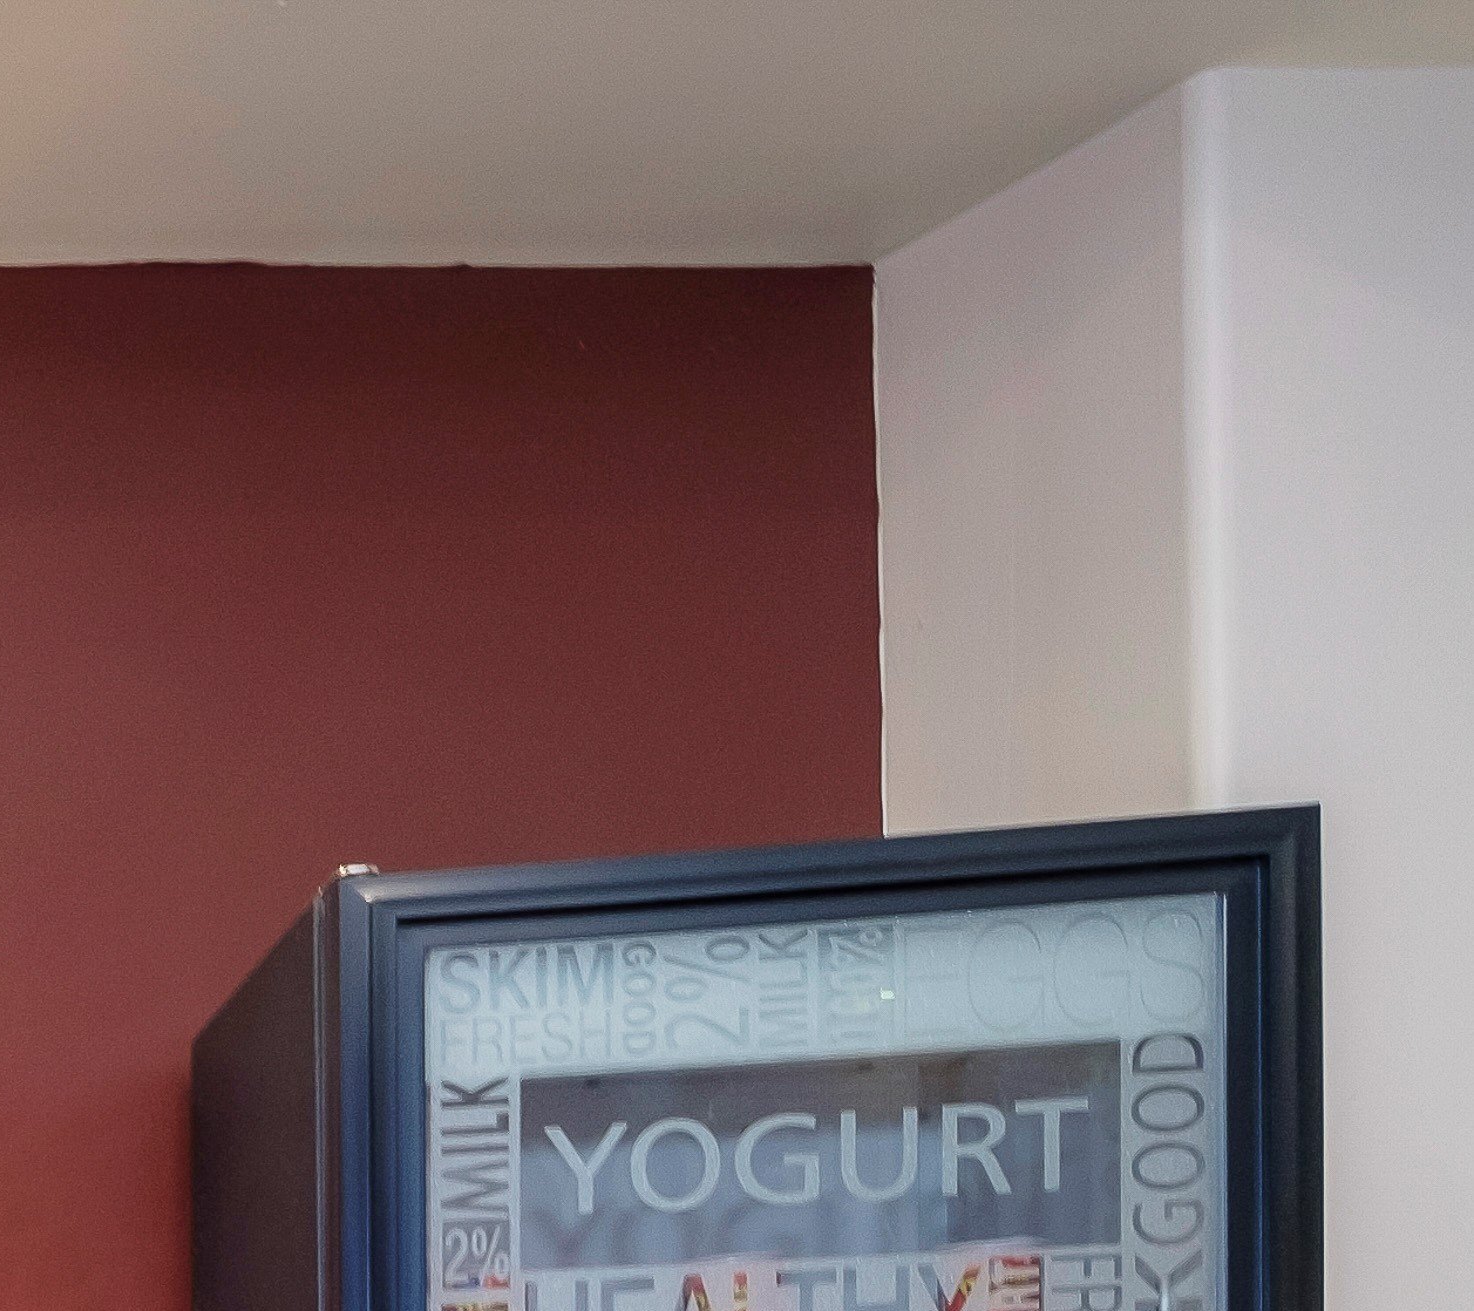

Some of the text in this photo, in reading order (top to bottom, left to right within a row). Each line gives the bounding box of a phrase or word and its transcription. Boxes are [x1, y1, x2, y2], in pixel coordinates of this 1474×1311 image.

[440, 944, 615, 1014] SKIM
[622, 941, 656, 1056] GOOD
[664, 934, 752, 1047] 2%
[758, 929, 809, 1047] MILK
[903, 909, 1205, 1036] EGGS
[440, 1010, 613, 1067] FRESH
[441, 1076, 510, 1221] MILK
[544, 1097, 1089, 1216] YOGURT
[1131, 1032, 1205, 1245] GOOD
[444, 1228, 510, 1283] 2%
